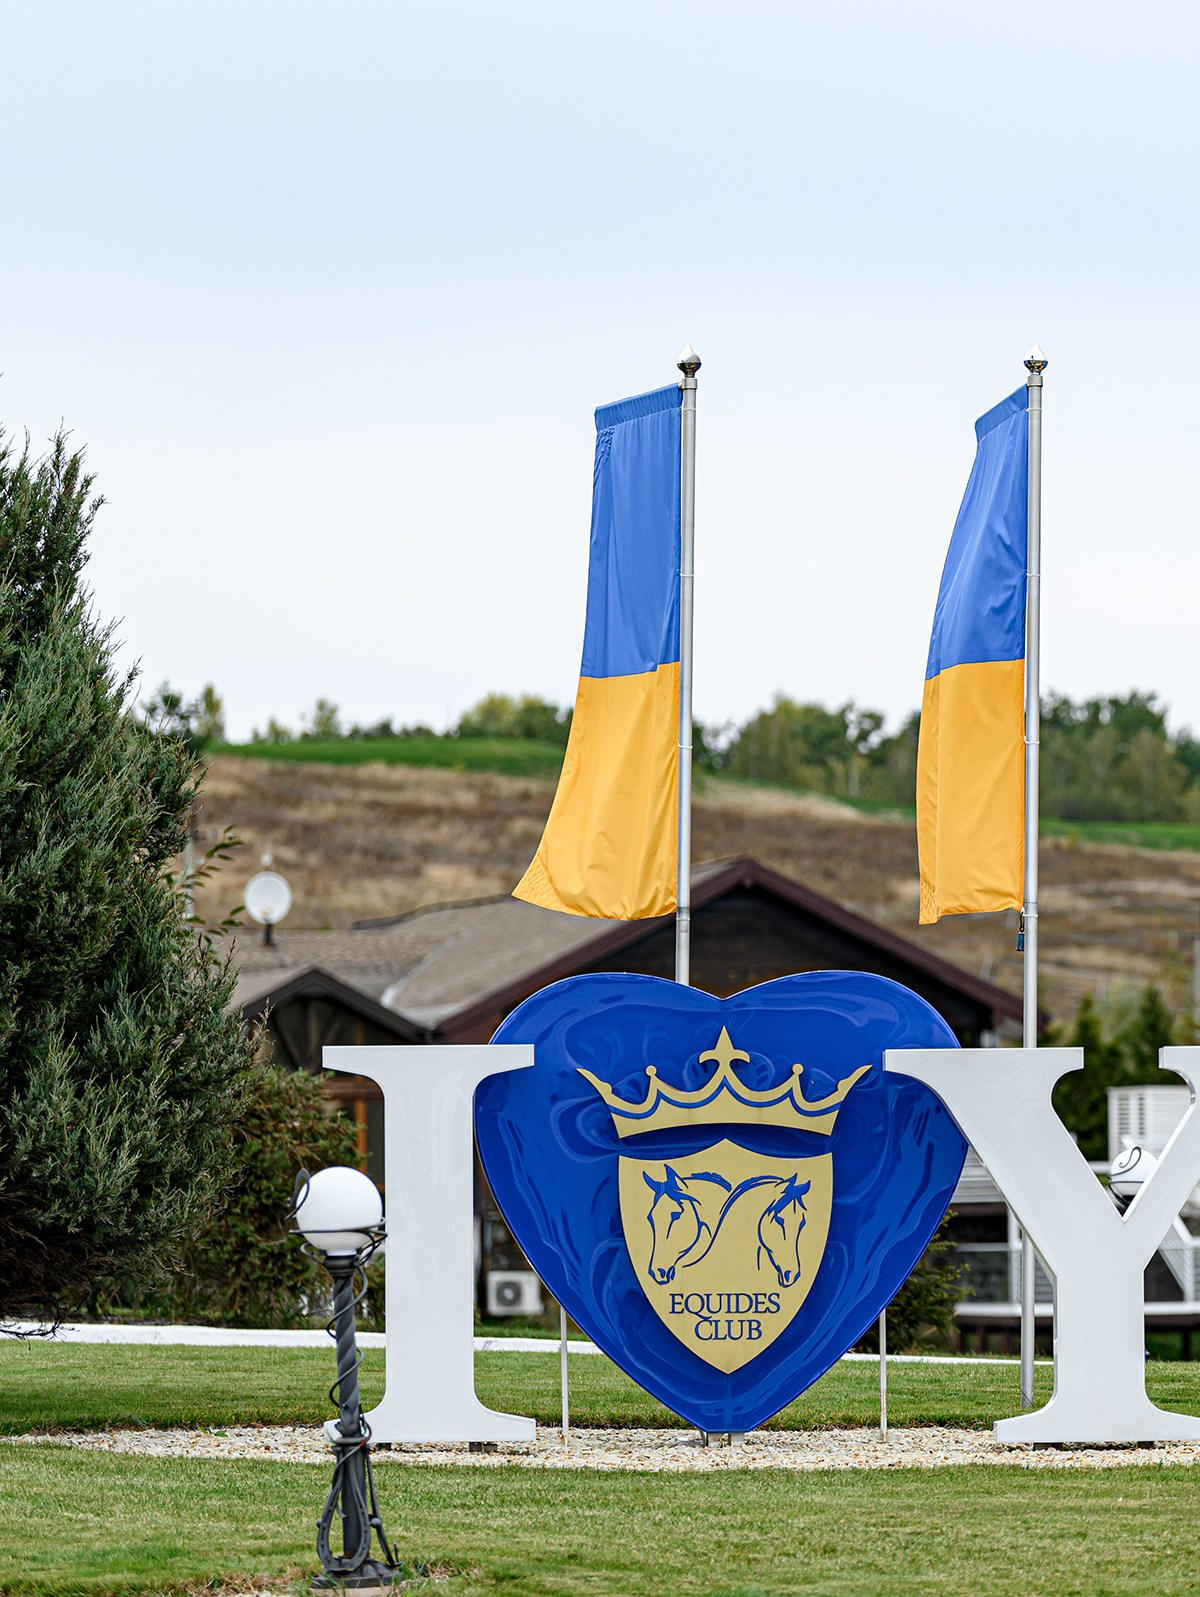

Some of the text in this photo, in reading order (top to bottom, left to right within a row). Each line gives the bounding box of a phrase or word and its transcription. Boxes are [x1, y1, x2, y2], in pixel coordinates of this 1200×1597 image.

[322, 1044, 536, 1442] I
[669, 1292, 781, 1320] EQUIDES
[694, 1319, 763, 1341] CLUB
